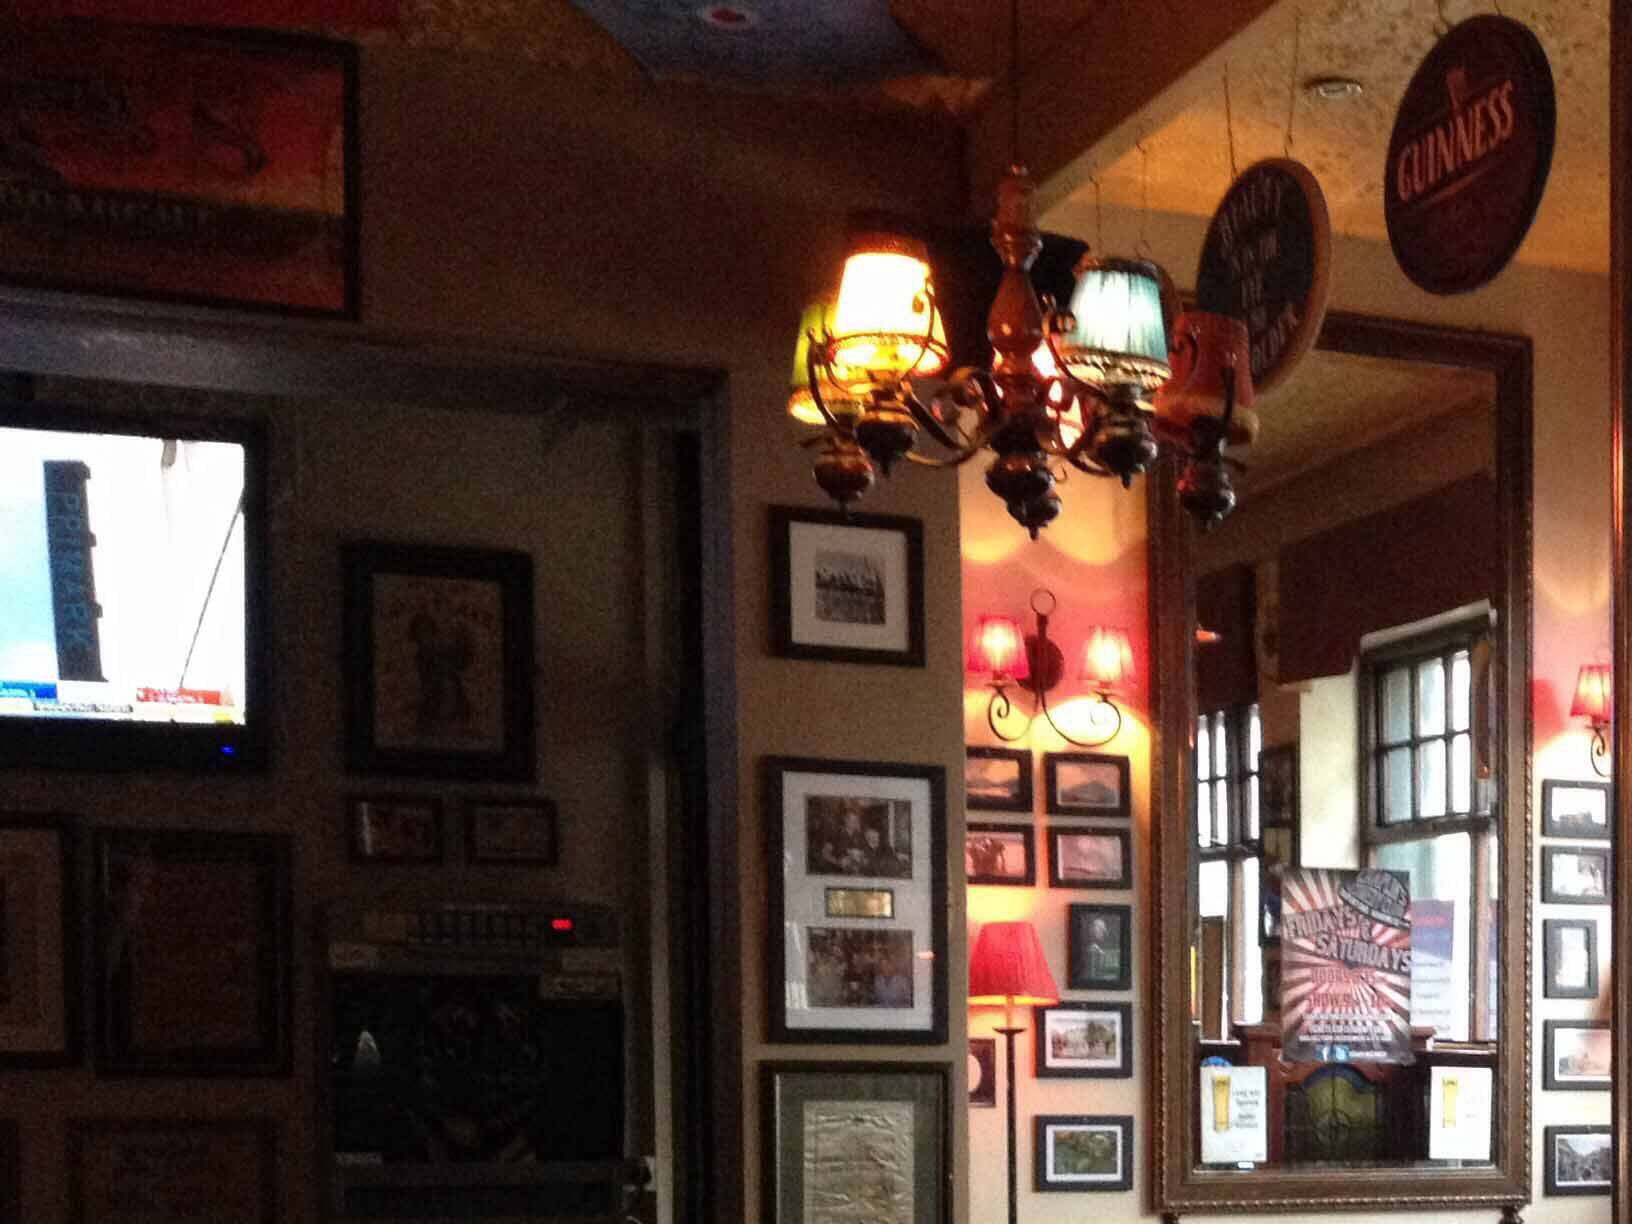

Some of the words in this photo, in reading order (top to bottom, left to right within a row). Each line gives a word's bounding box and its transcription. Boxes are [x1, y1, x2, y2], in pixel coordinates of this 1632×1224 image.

[1397, 79, 1516, 204] GUINNESS
[1284, 906, 1358, 939] FRIDAYS
[1315, 928, 1412, 975] SATURDAYS
